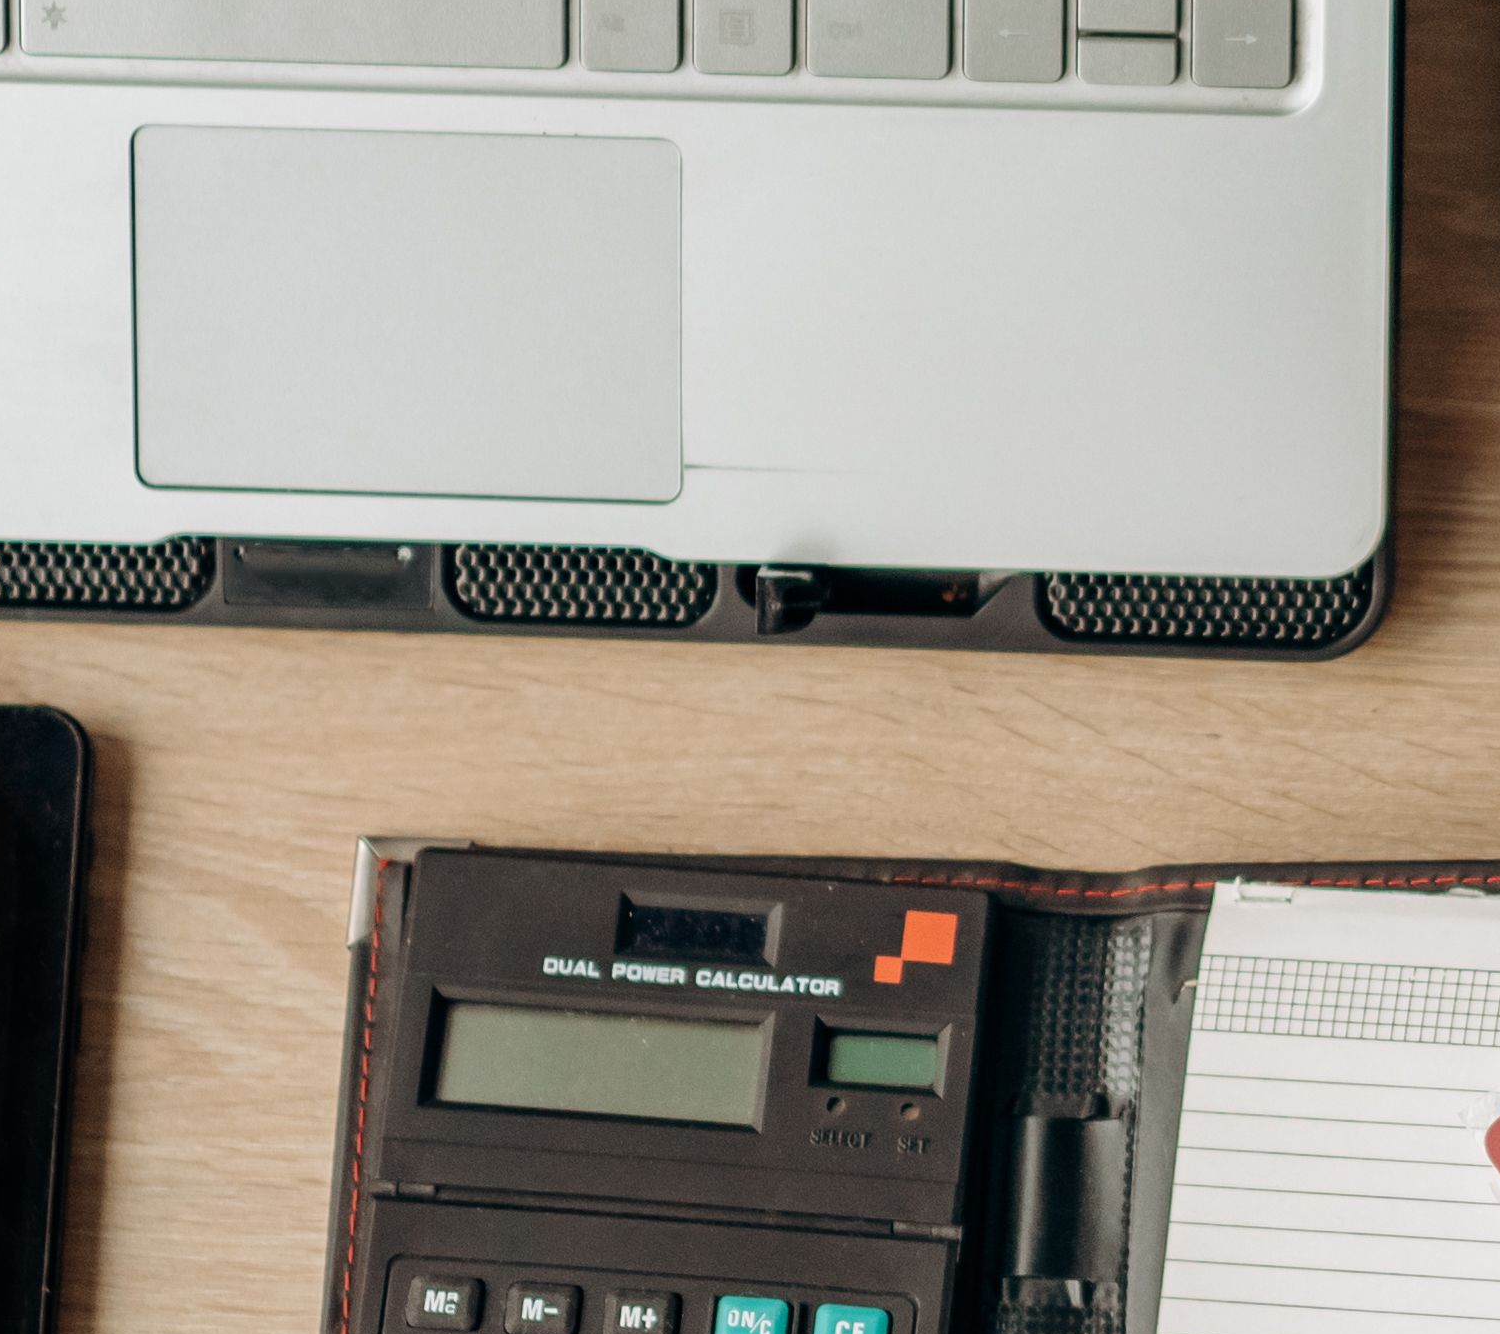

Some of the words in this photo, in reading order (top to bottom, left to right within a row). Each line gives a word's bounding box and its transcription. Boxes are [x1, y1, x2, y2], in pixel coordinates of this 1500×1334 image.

[541, 955, 600, 979] DUAL
[611, 962, 686, 986] POWER
[695, 969, 843, 997] CALCULATOR
[808, 1128, 873, 1150] SELECT
[896, 1136, 930, 1155] SET
[619, 1306, 658, 1331] M+
